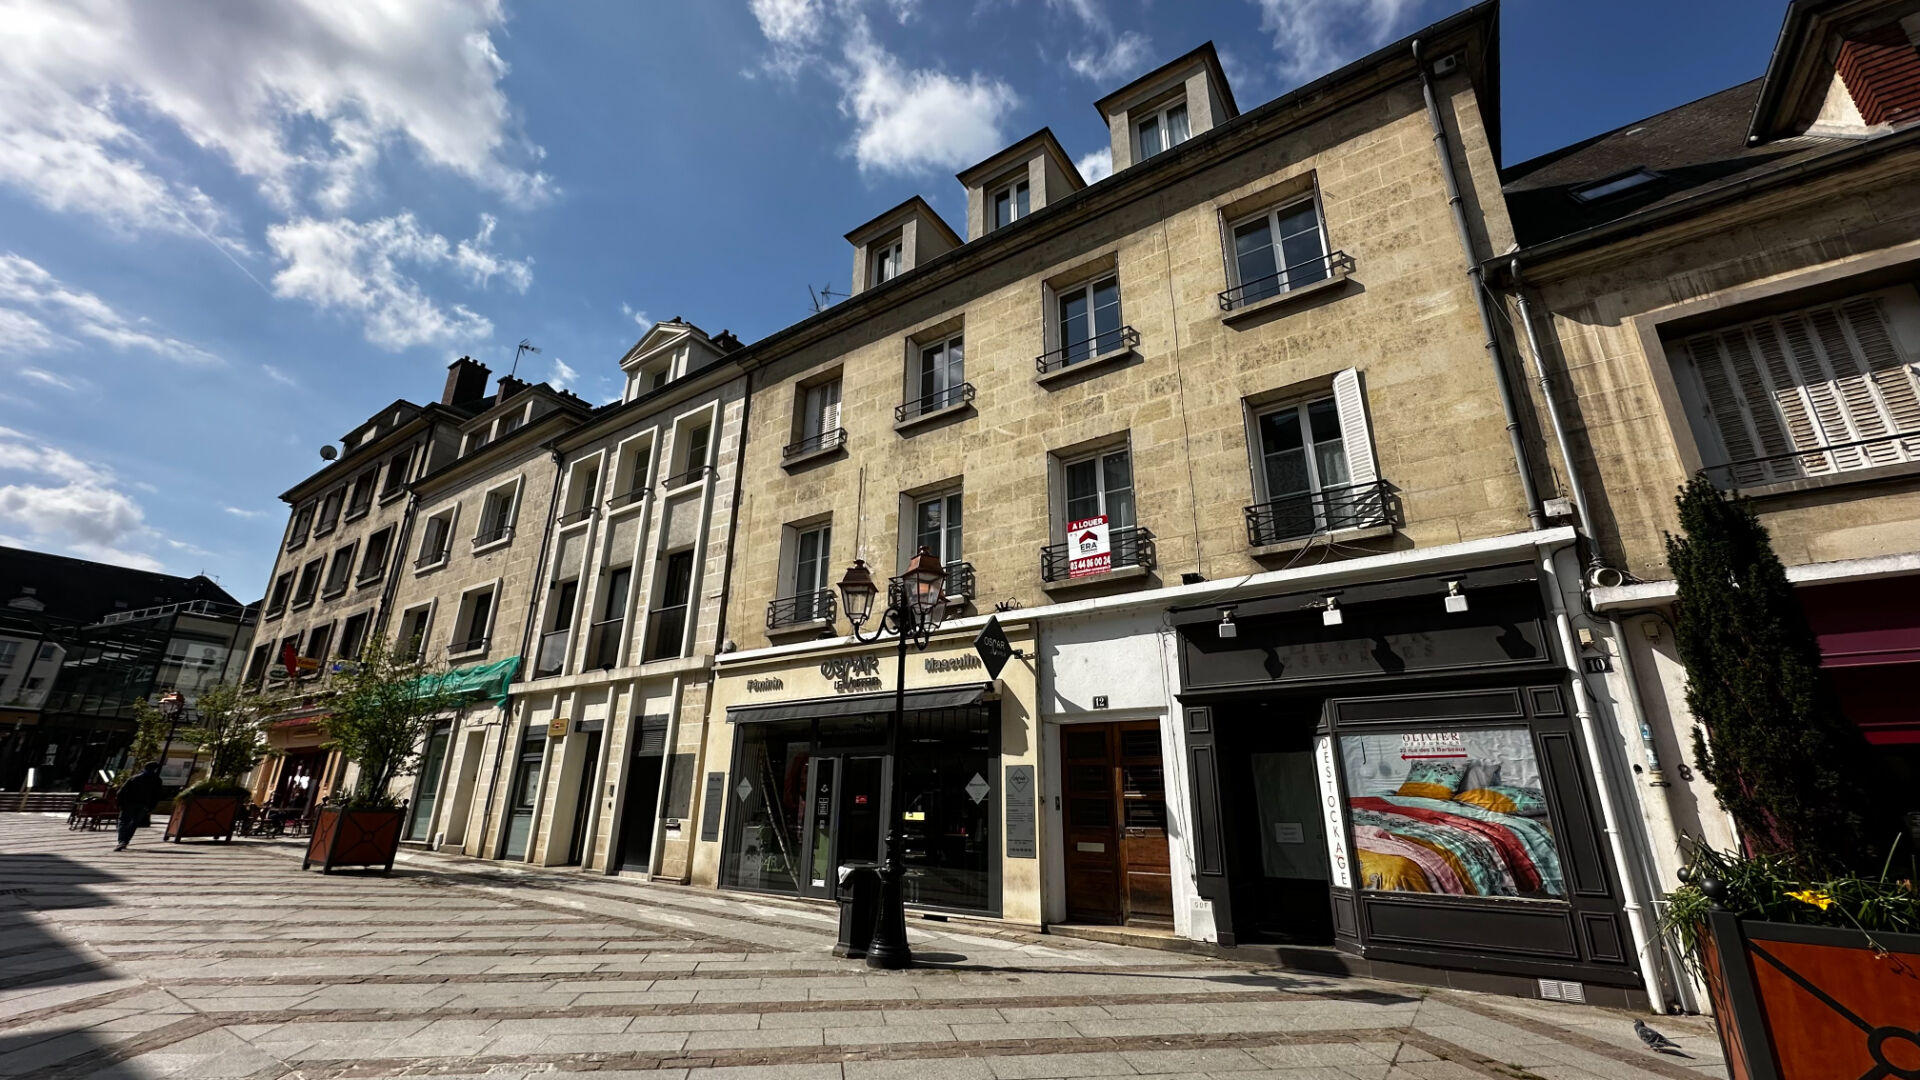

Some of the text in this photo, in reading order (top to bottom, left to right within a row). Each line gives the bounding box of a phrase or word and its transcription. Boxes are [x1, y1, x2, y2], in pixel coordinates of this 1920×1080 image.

[1079, 518, 1103, 528] LOUER
[1080, 542, 1097, 550] ERA
[1078, 559, 1086, 569] 44
[1094, 556, 1103, 566] 00
[984, 636, 1005, 651] OSCAR
[820, 655, 880, 680] OSCAR
[925, 654, 981, 673] Masculin
[1588, 658, 1606, 672] 10
[747, 677, 783, 693] Féminin
[1095, 697, 1105, 706] 12
[1402, 732, 1459, 742] OLIVIER
[1678, 764, 1694, 781] 8
[1321, 737, 1347, 885] DESTOCKAGE
